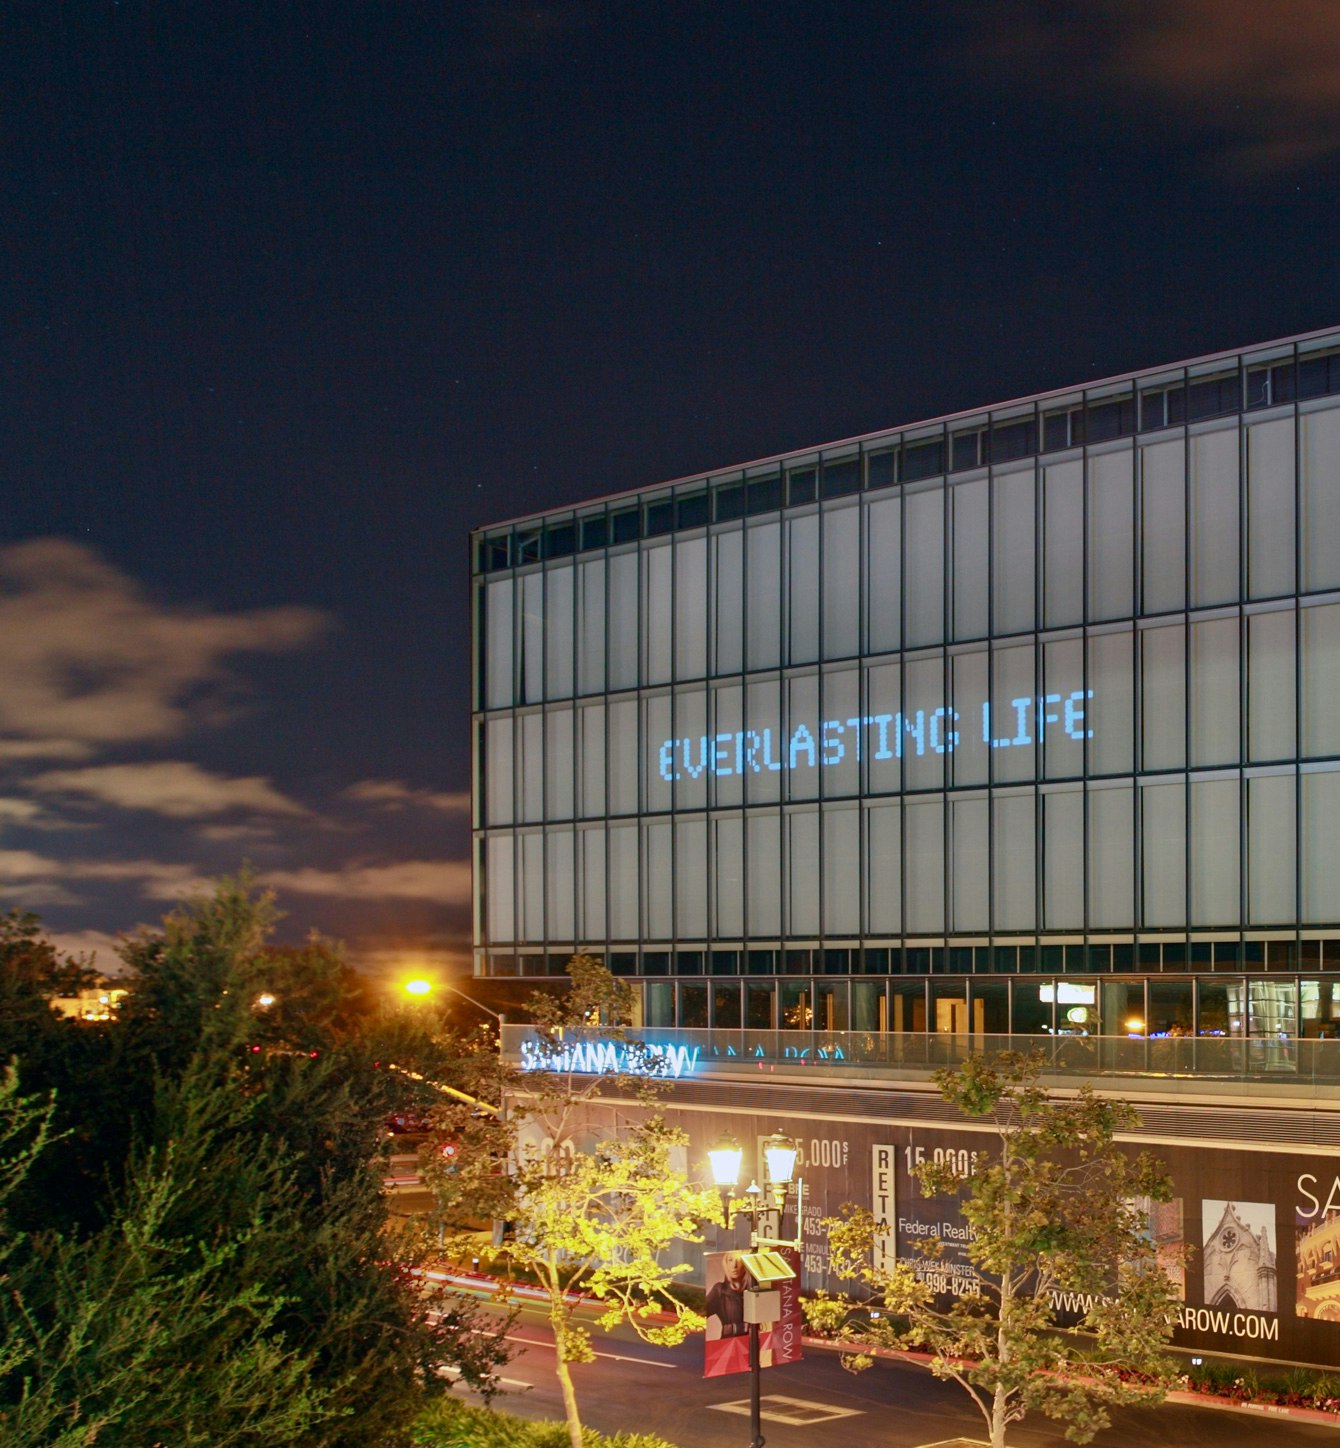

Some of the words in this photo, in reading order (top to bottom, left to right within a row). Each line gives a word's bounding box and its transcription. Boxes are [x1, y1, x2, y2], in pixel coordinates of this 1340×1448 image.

[659, 705, 960, 782] EVERLASTING
[981, 689, 1095, 749] LIFE
[877, 1149, 891, 1270] RETAI
[898, 1217, 941, 1238] Federal
[780, 1247, 793, 1319] SATANA
[782, 1323, 794, 1360] ROW
